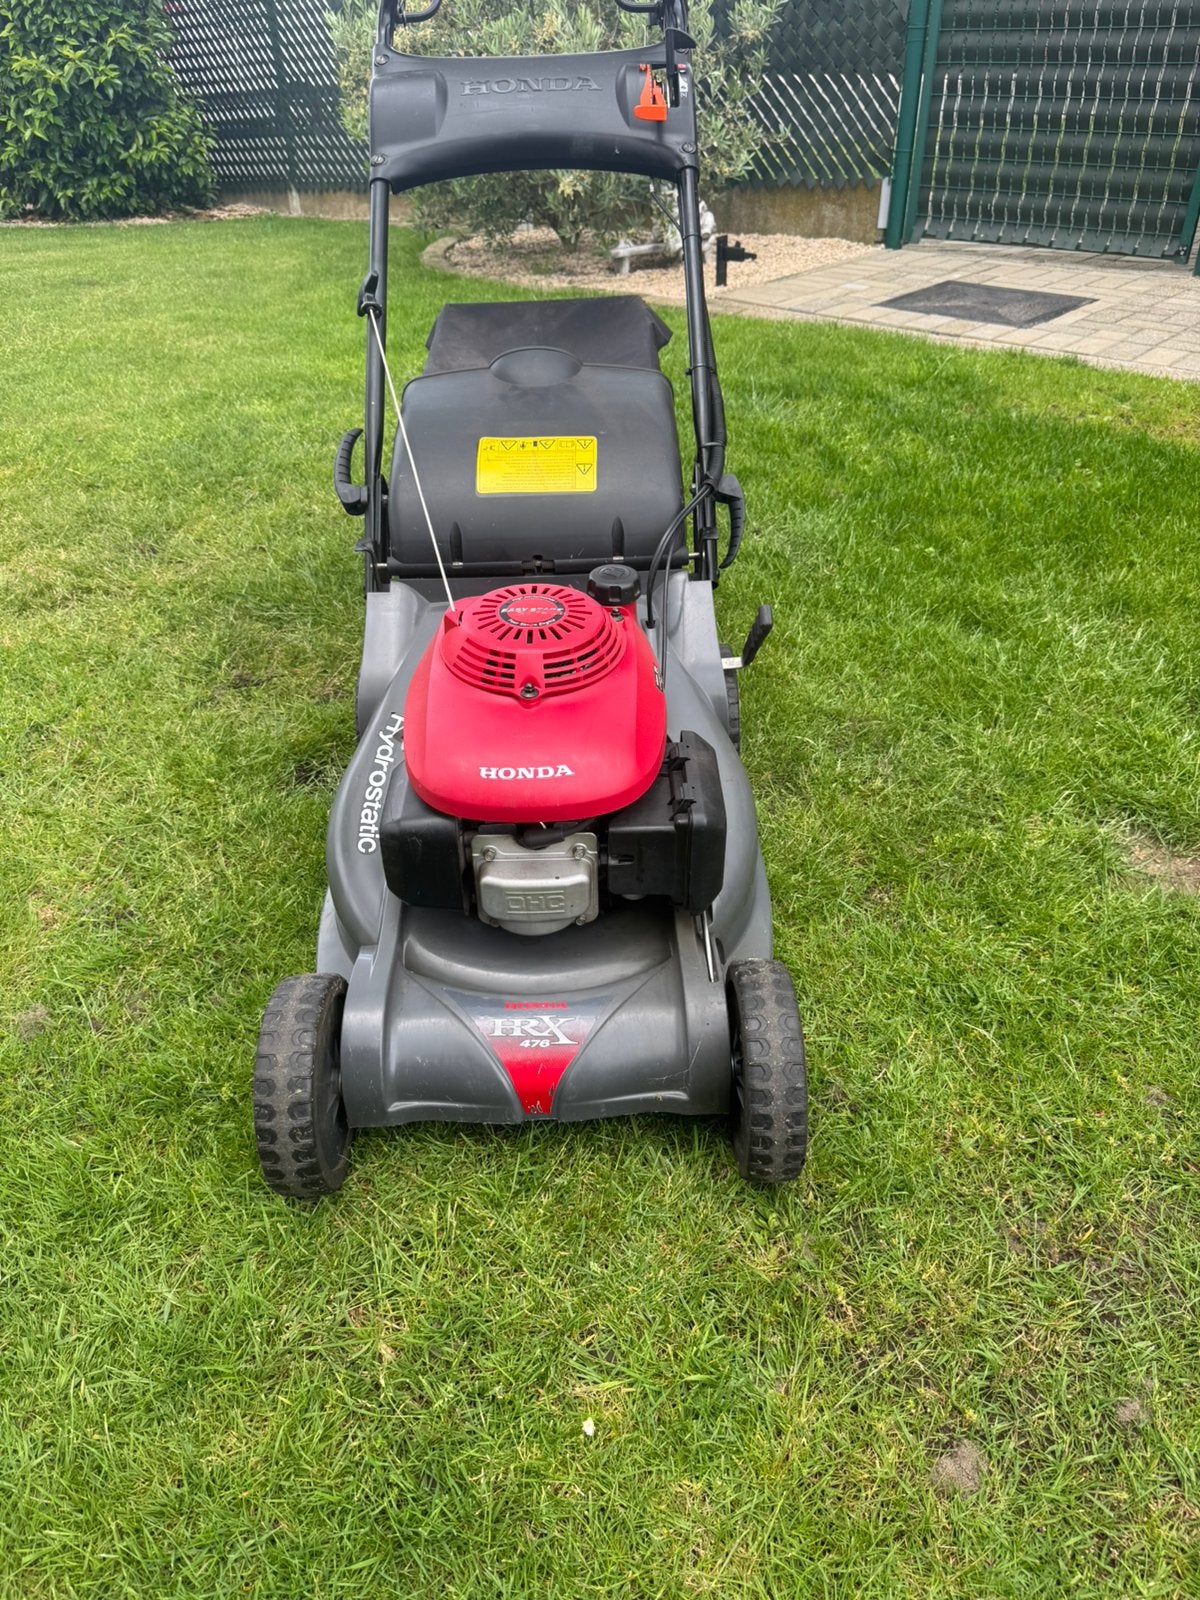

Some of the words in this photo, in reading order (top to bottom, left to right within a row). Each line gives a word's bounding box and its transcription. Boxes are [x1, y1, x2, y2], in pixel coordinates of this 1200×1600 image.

[460, 77, 602, 97] HONDA
[479, 764, 575, 780] HONDA
[357, 713, 404, 854] Hydrostatic
[504, 1001, 568, 1010] HONDA
[488, 1014, 579, 1045] HRX
[519, 1039, 551, 1048] 476
